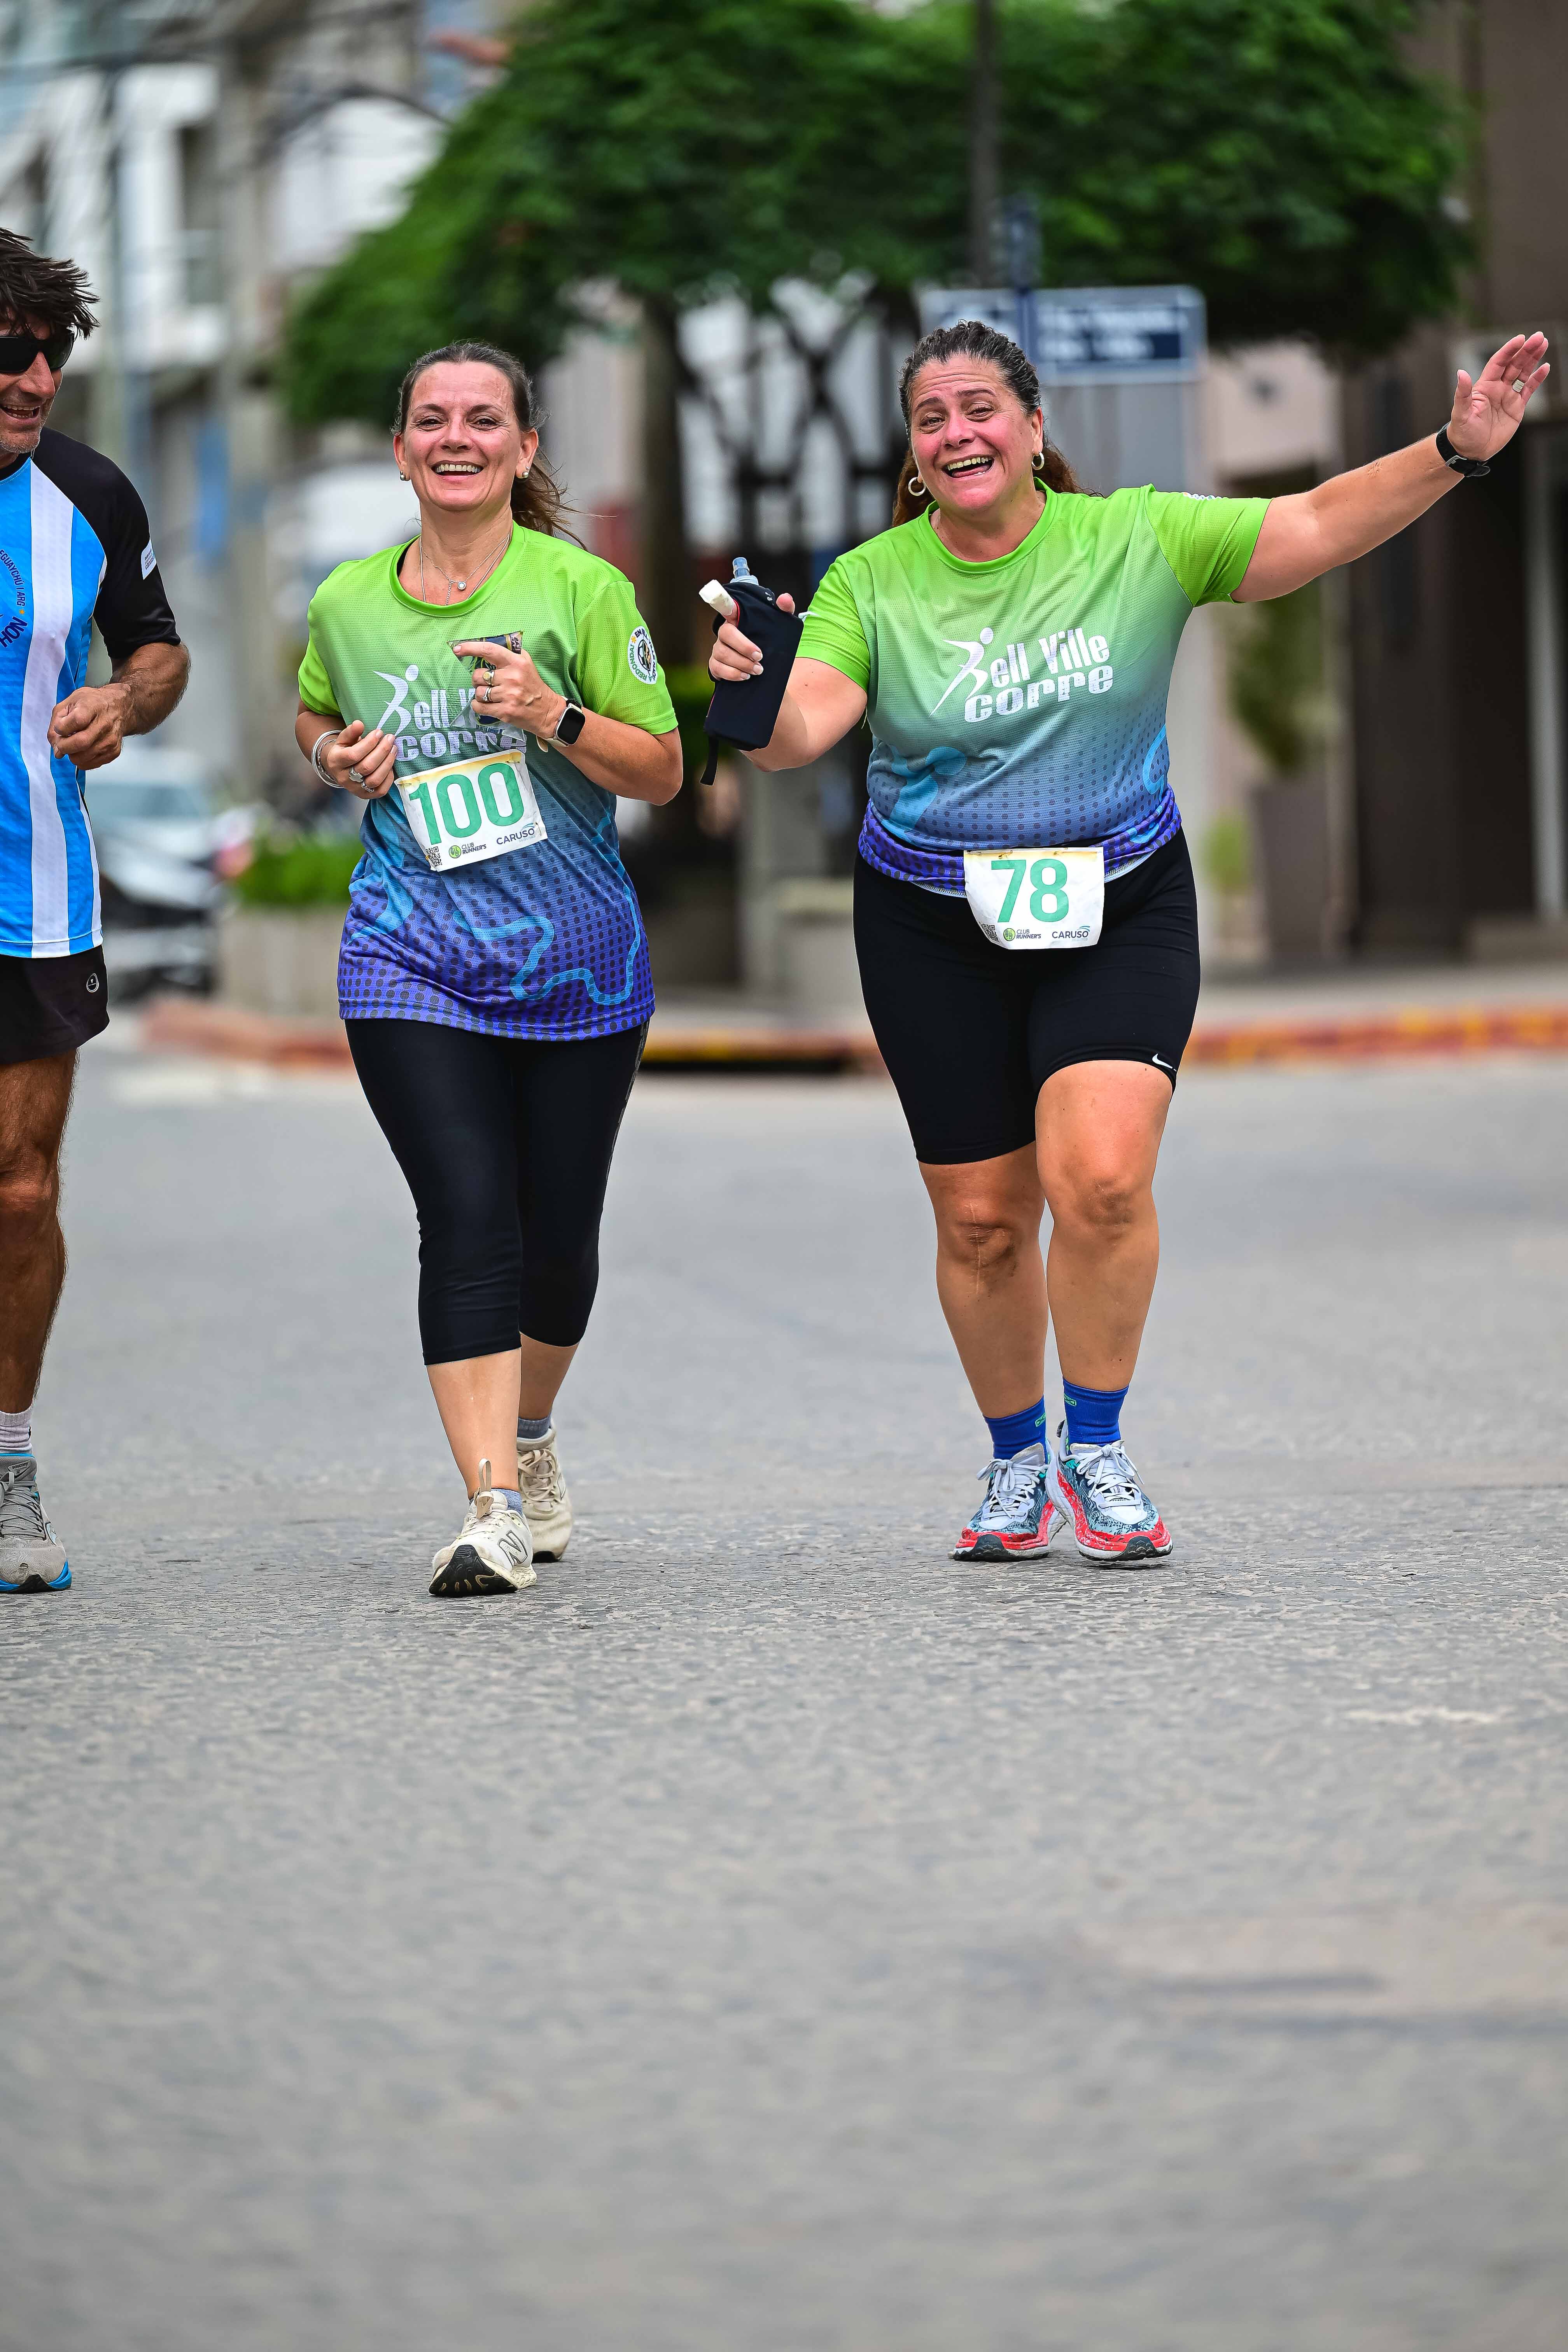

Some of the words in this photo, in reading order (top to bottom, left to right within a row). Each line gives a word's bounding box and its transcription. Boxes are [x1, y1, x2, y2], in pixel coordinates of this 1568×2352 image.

[16, 591, 26, 607] ARG
[634, 628, 642, 638] EN
[1038, 626, 1110, 674] Ville
[964, 665, 1113, 723] corre
[409, 763, 524, 845] 100
[496, 828, 535, 845] CARUSO
[462, 844, 487, 855] RUNNER'S
[991, 859, 1069, 923] 78
[1052, 931, 1089, 939] CARUSO
